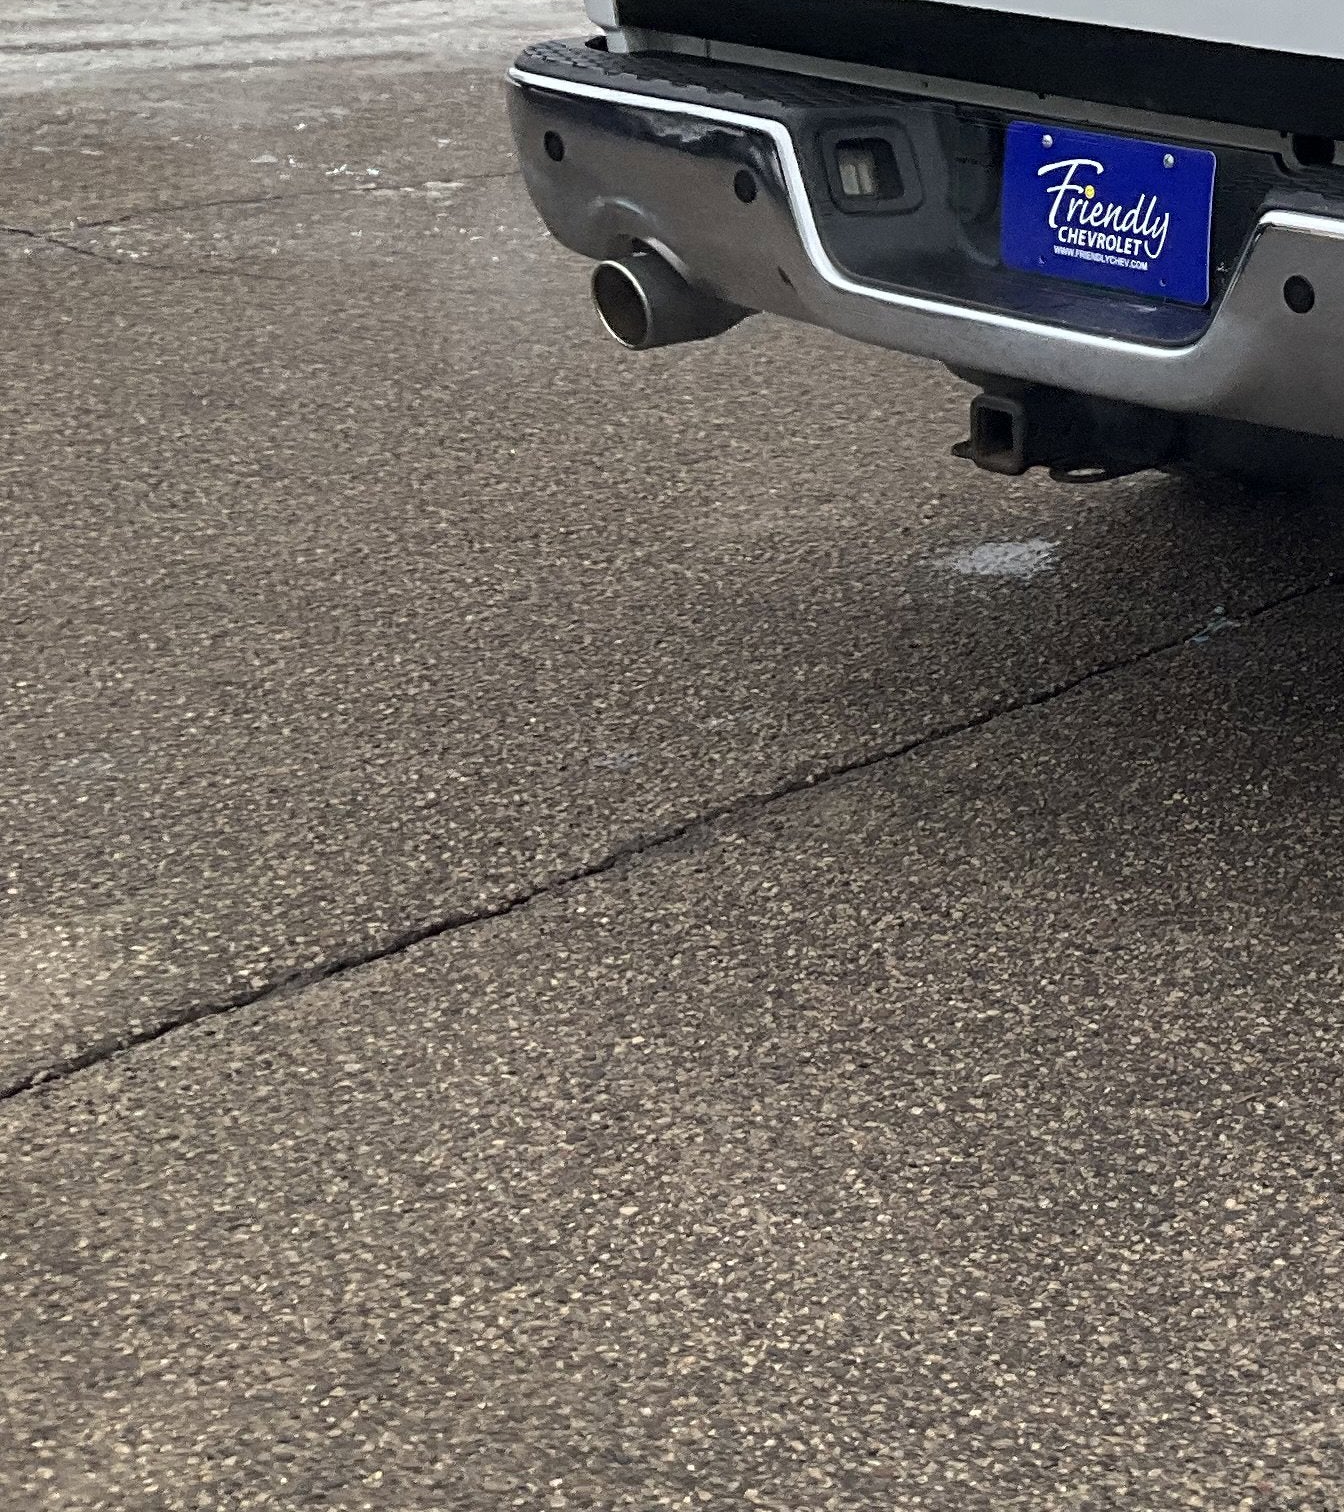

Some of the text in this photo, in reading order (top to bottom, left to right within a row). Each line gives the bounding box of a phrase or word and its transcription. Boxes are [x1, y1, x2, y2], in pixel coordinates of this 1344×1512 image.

[1037, 158, 1170, 259] Friendly
[1057, 226, 1143, 256] CHEVROLET
[1053, 245, 1149, 271] WWW.FRIENDLYCHEV.COM
